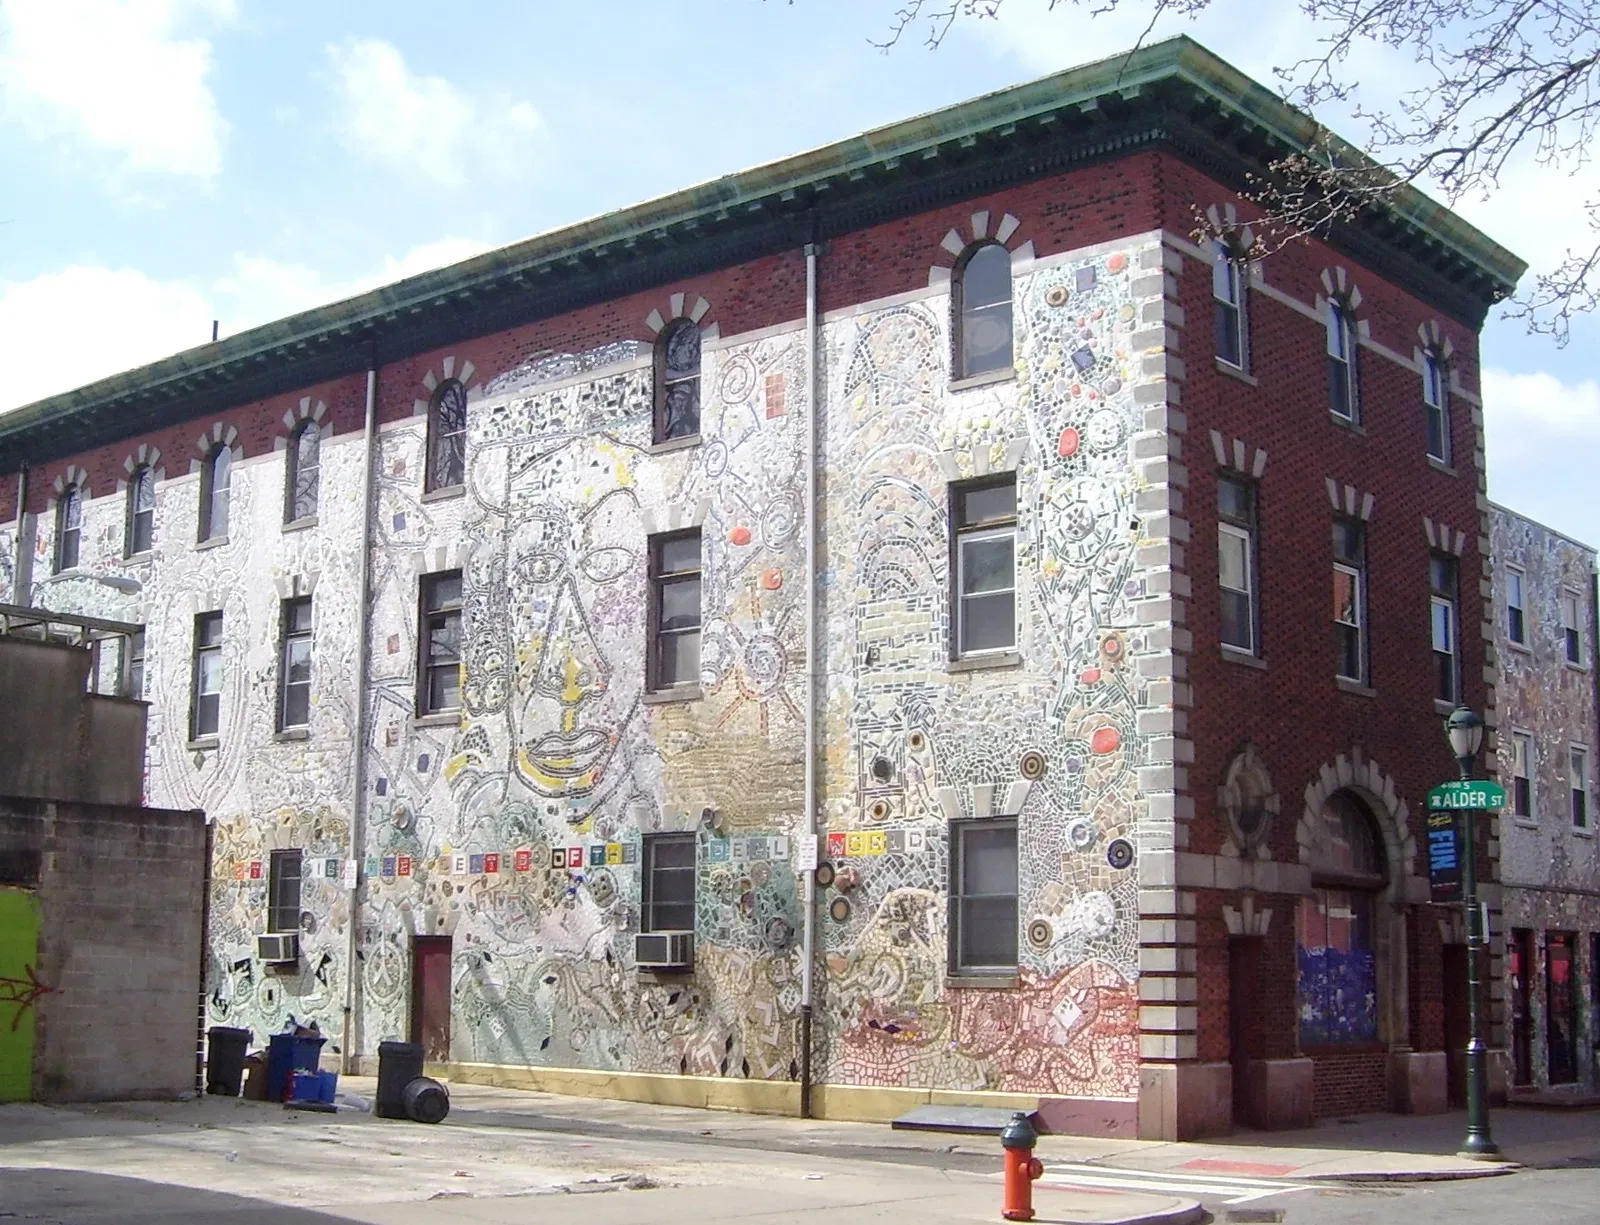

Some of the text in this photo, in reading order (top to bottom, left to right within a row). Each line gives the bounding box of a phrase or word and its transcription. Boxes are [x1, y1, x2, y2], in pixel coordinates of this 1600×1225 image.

[1463, 782, 1470, 790] S
[1443, 791, 1502, 807] ALDER ST
[553, 848, 583, 868] OF
[592, 844, 635, 865] THE
